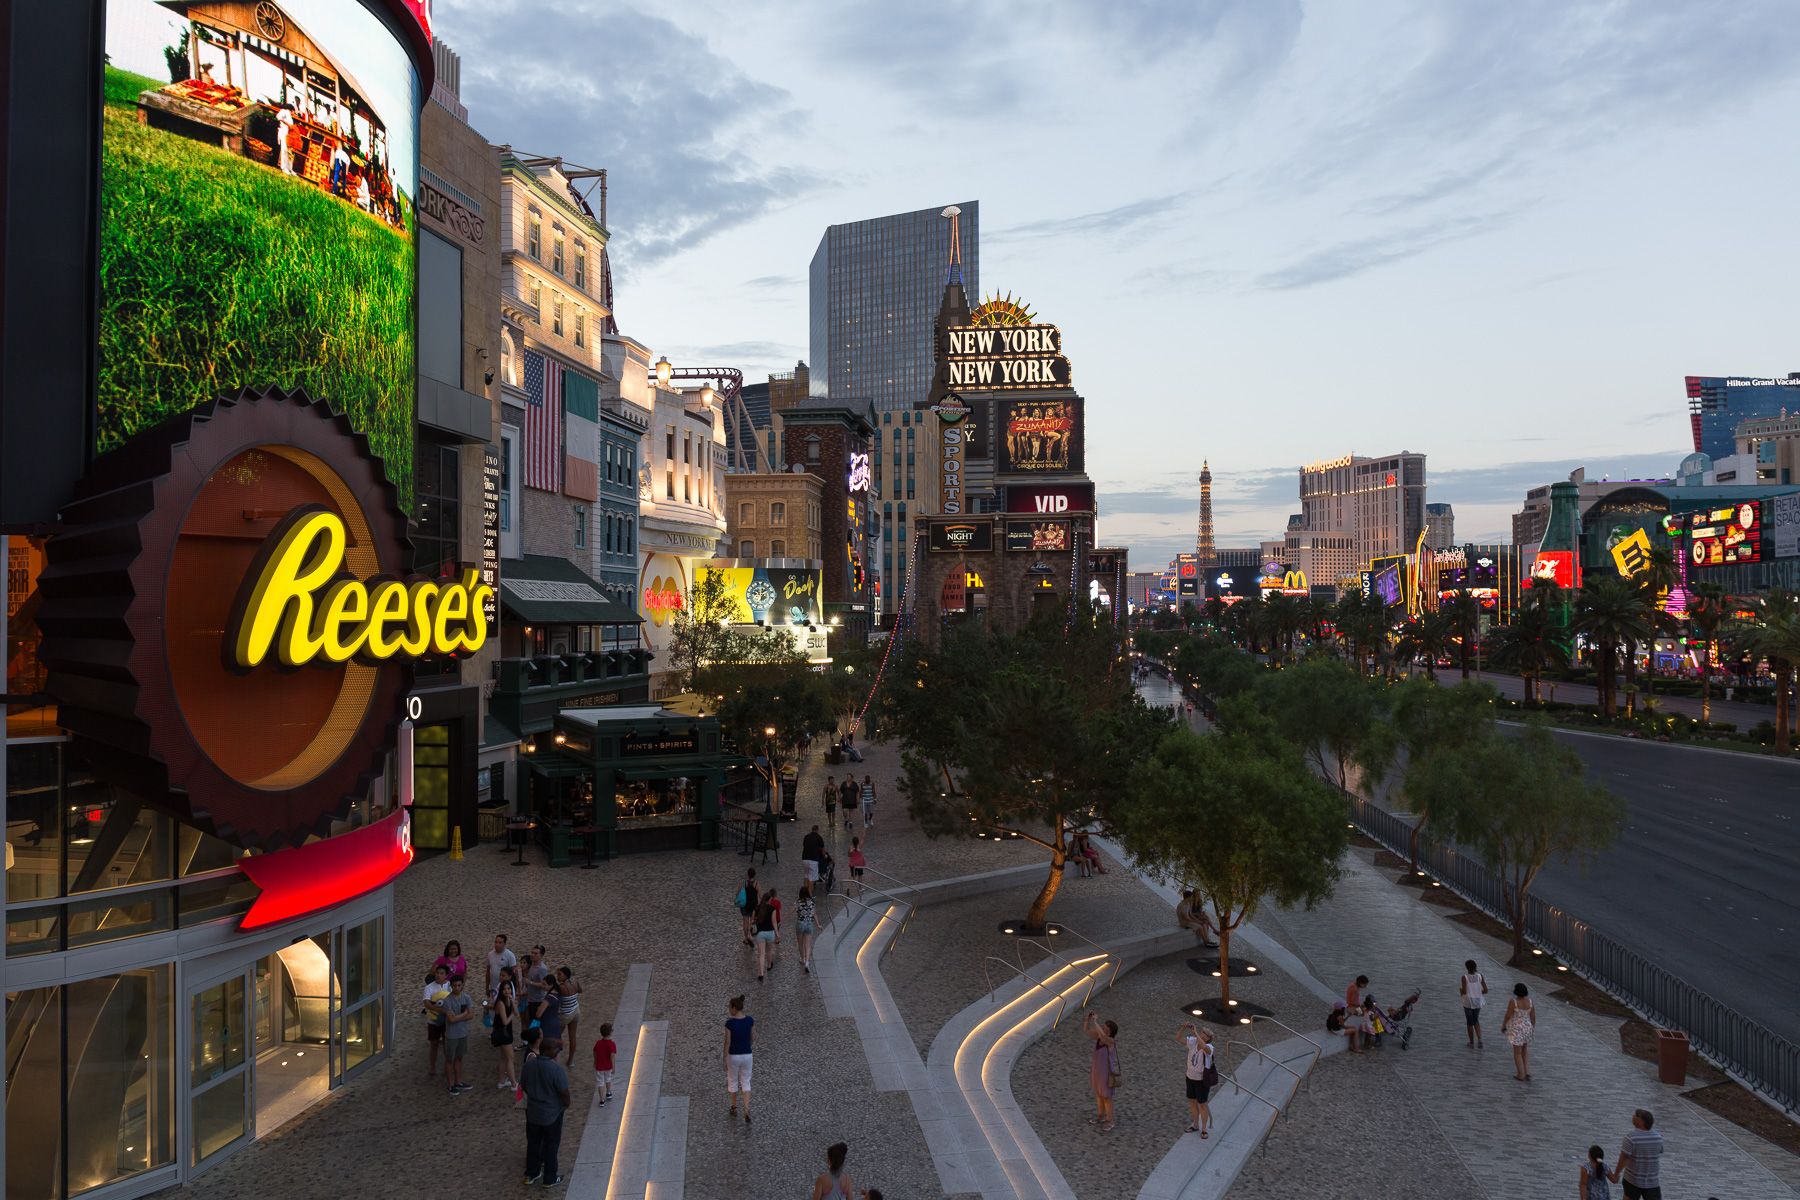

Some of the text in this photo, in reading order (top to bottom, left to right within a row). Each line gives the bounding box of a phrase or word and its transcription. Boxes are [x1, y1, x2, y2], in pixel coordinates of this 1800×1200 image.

[949, 328, 1056, 354] NEW YORK
[949, 359, 1056, 385] NEW YORK
[1726, 379, 1751, 387] Hilton
[1752, 378, 1775, 386] Grand
[1015, 419, 1064, 431] ZUMANITY
[943, 428, 961, 514] SPORTS
[947, 532, 974, 541] NIGHT
[237, 511, 494, 667] Reese's
[660, 740, 693, 749] SPIRITS
